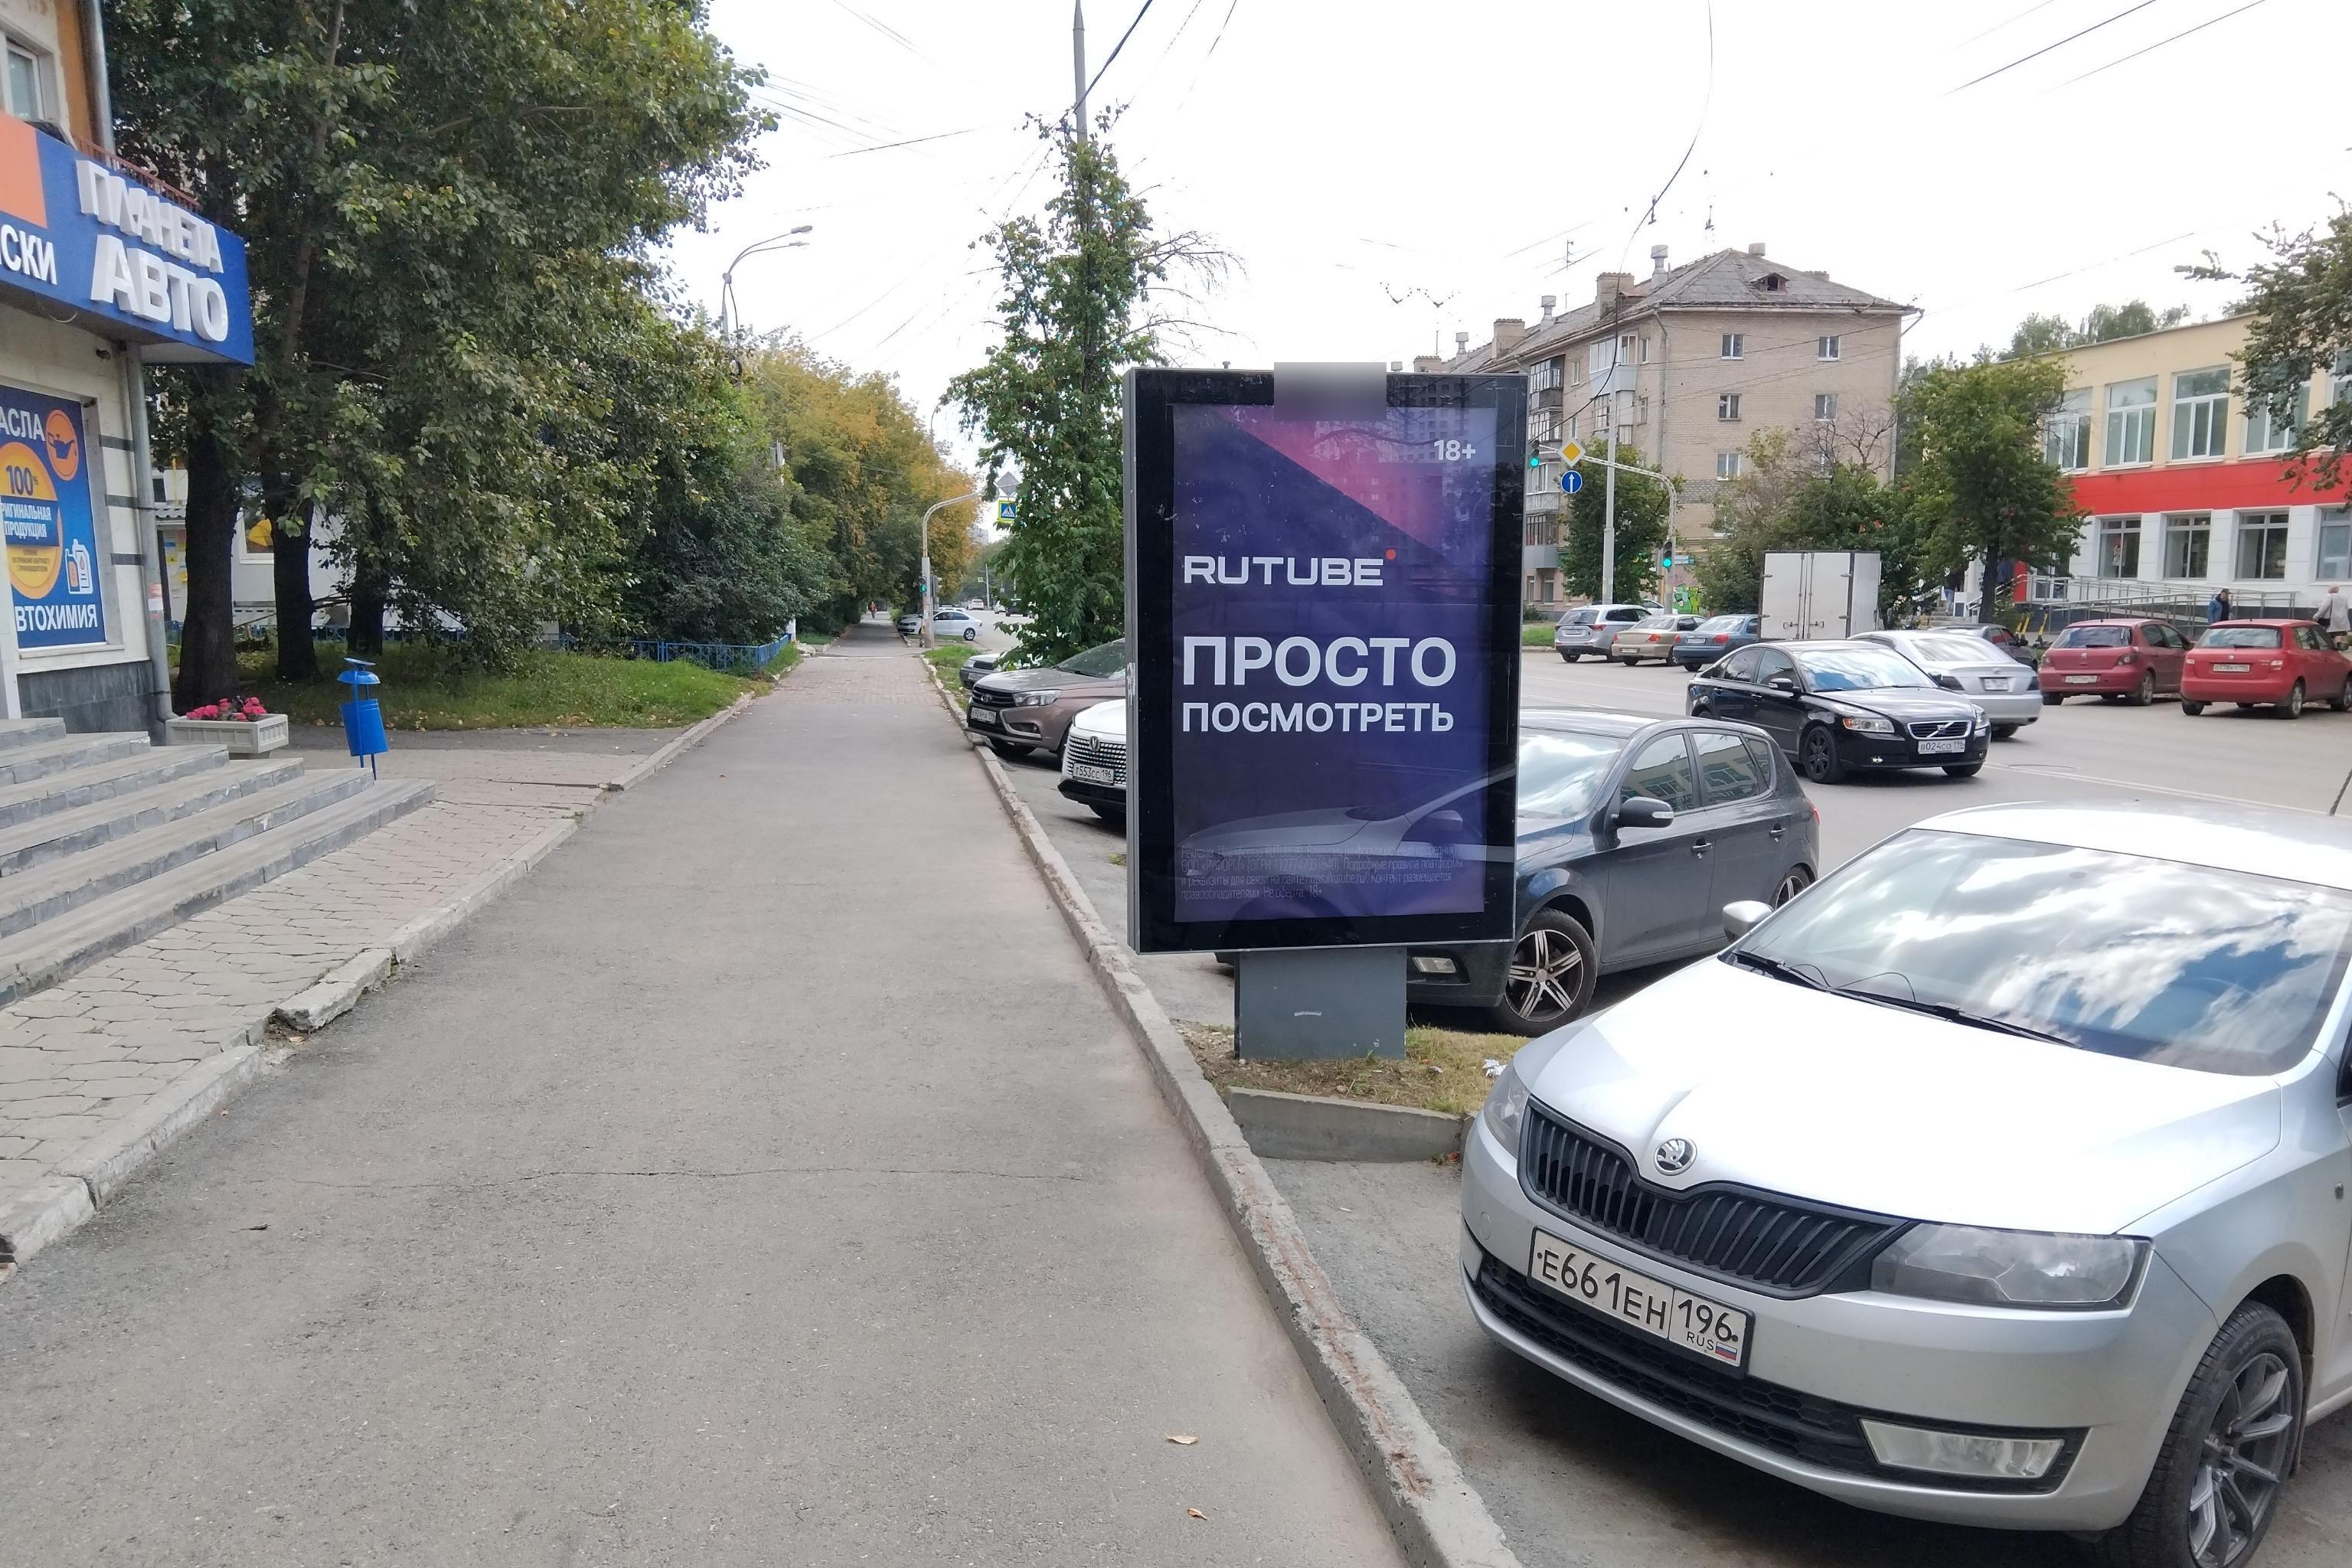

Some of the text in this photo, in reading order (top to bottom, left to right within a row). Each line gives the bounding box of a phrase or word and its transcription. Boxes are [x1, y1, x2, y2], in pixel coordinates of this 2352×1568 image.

[77, 160, 224, 273] ПЛАНЕТА
[0, 224, 57, 285] СКИ
[91, 234, 228, 341] АВТО
[0, 407, 45, 442] АСЛА
[1434, 439, 1476, 461] 18+
[0, 502, 51, 521] РИГИНАЛЬНАЯ
[4, 521, 47, 540] ПРОДУКЦИЯ
[1184, 555, 1384, 586] RUTUBE
[15, 604, 98, 632] ВТОХИМИЯ
[1183, 636, 1455, 687] ПРОСТО
[1183, 702, 1454, 732] ПОСМОТРЕТЬ
[1075, 766, 1112, 779] Т553СС 196
[1230, 875, 1244, 887] для
[1371, 871, 1401, 884] Контент
[1264, 886, 1274, 898] Не
[1309, 884, 1323, 898] 18+
[1541, 1249, 1733, 1343] Е661ЕН 196
[1687, 1331, 1715, 1351] RUS
